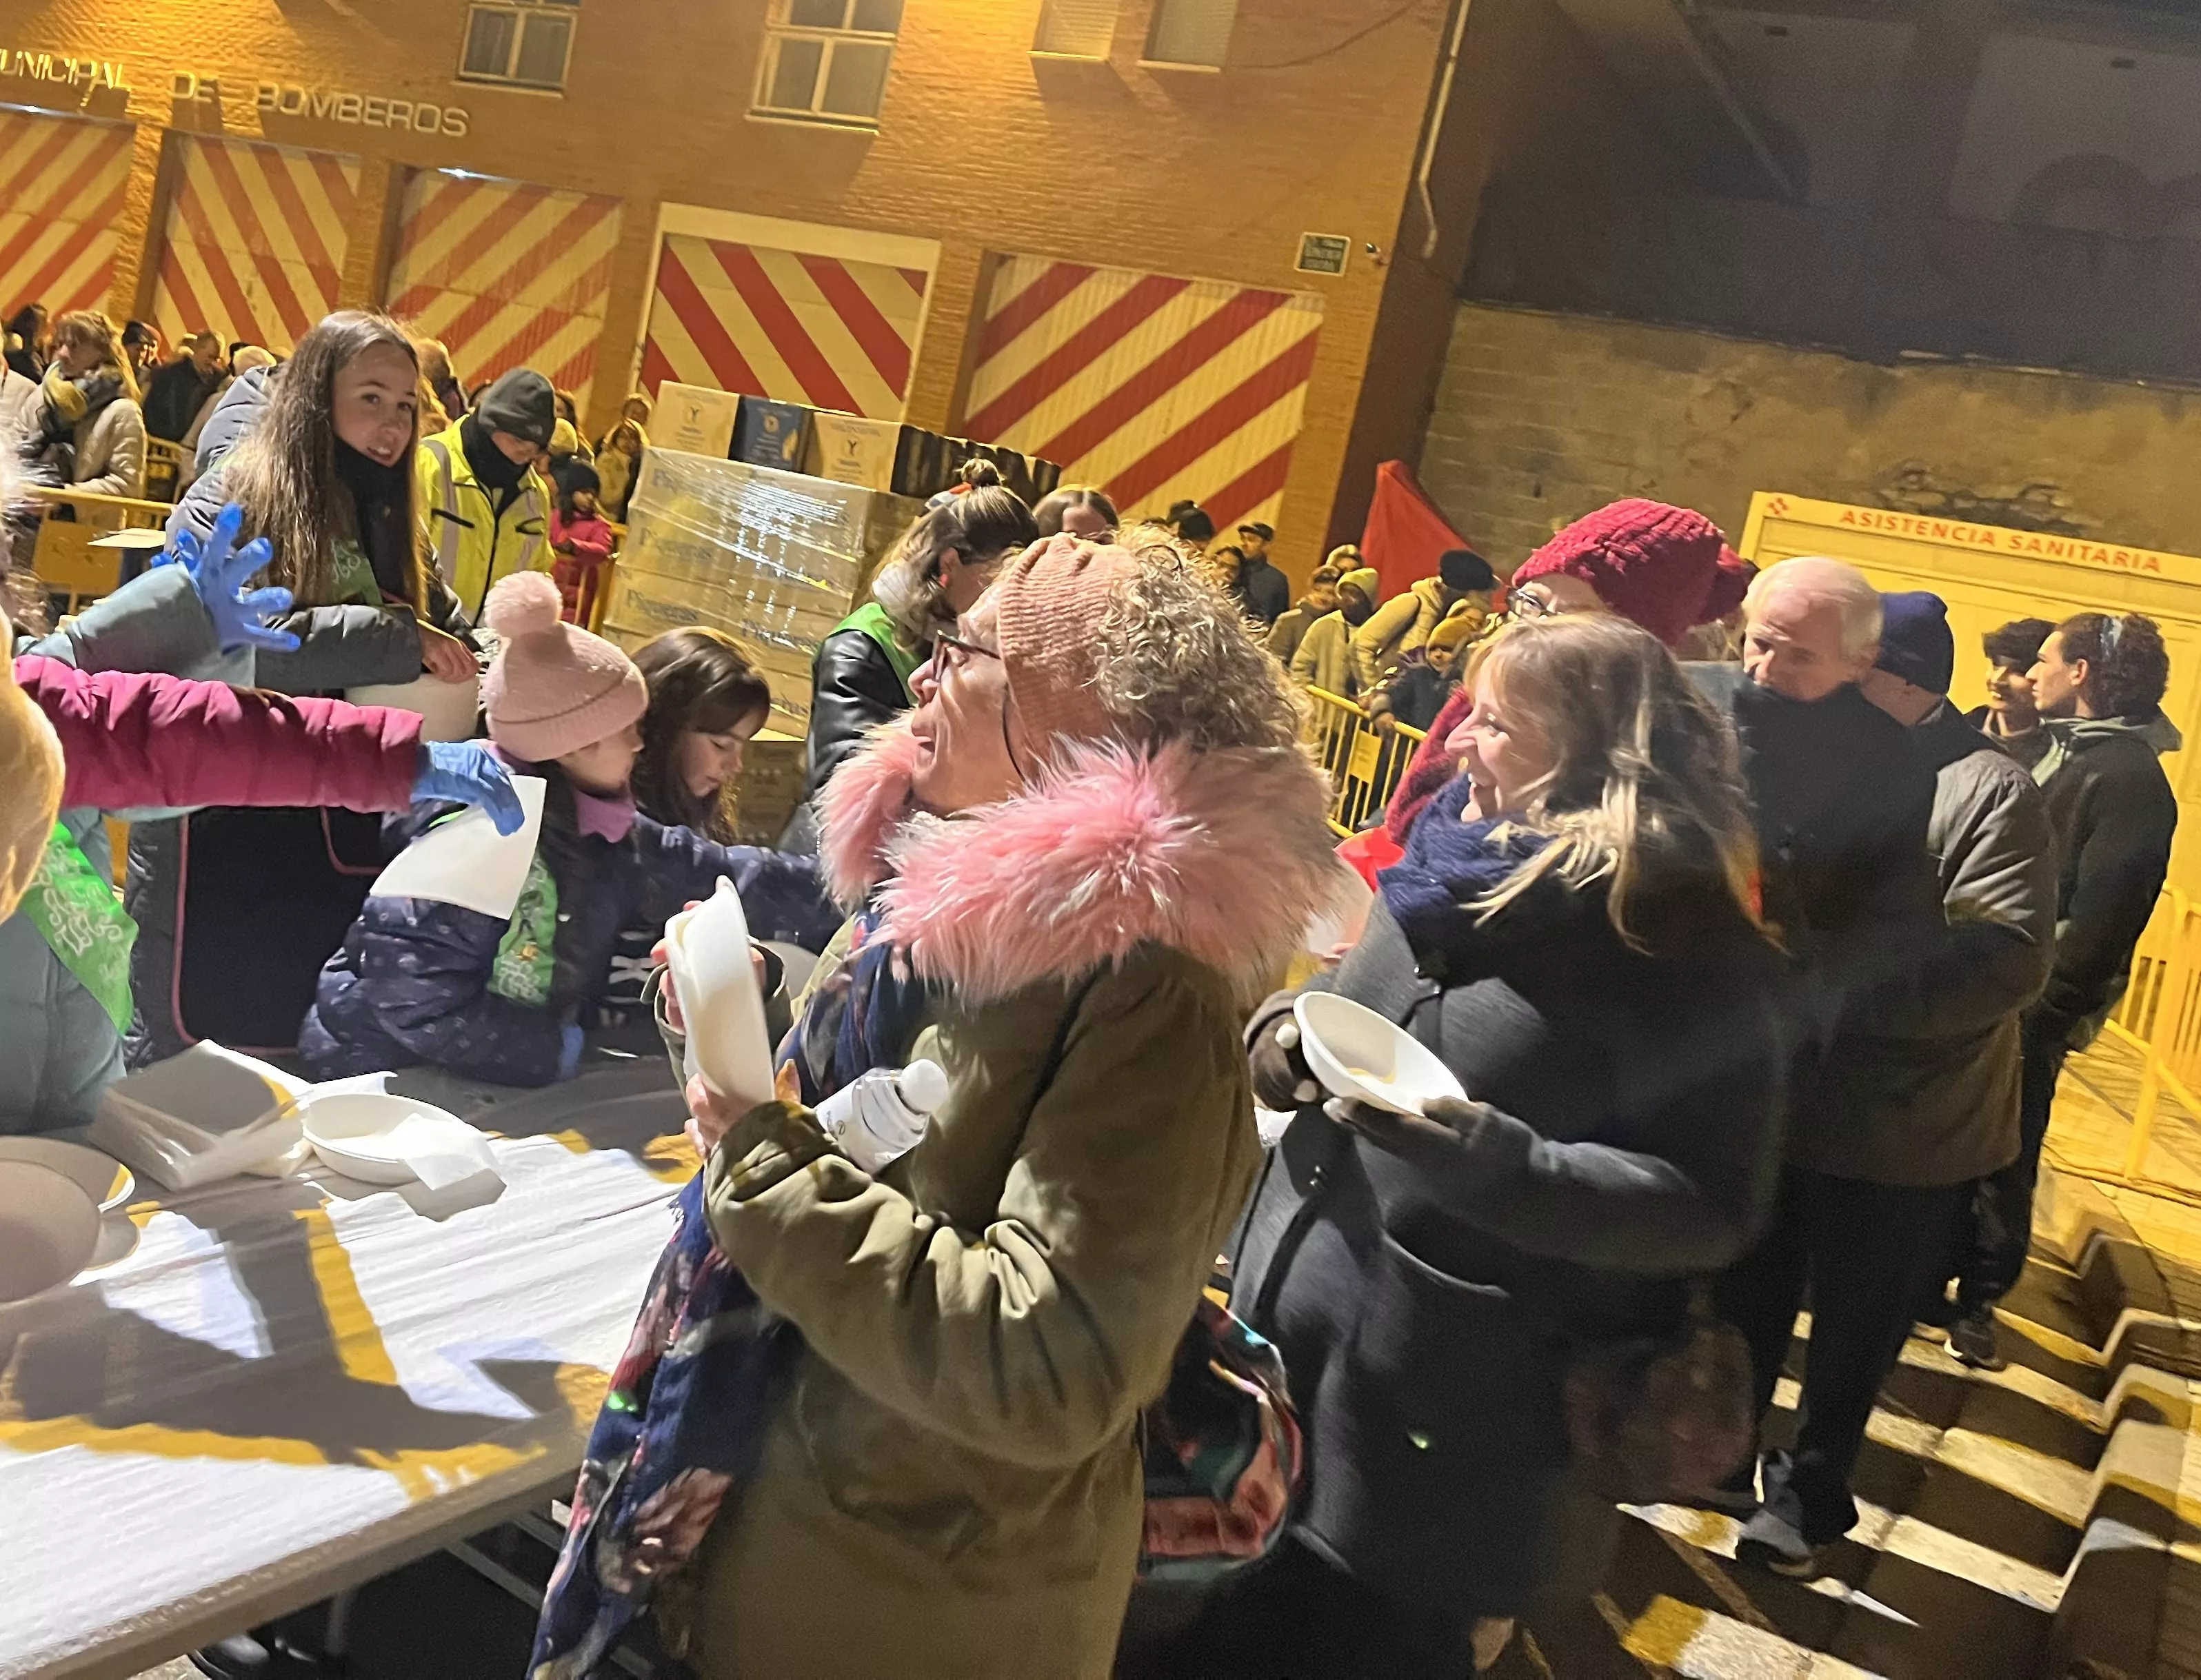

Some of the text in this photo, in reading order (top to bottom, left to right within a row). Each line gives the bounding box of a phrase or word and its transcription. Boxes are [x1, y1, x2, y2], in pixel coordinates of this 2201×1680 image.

[0, 48, 470, 137] UNICIPAL DE BOMBEROS
[1838, 510, 2161, 574] ASISTENCIA SANITARIA
